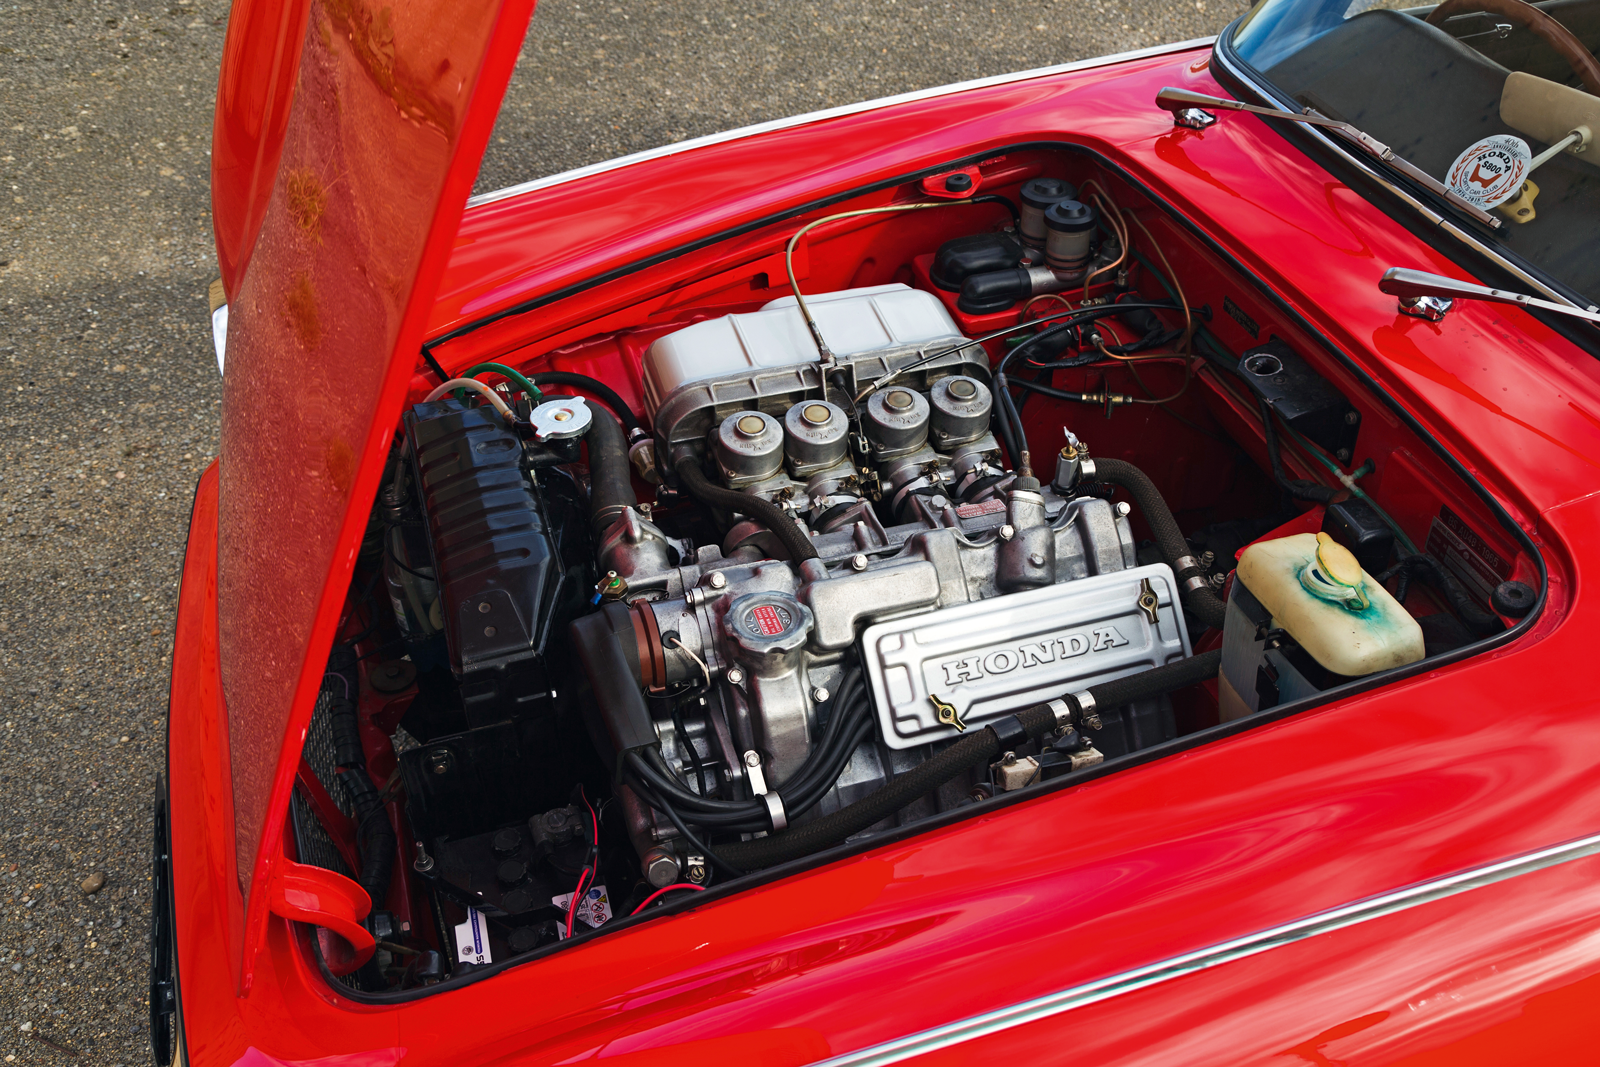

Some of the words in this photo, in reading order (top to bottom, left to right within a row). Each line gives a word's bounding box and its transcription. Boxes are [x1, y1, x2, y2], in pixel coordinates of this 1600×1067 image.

[1476, 151, 1512, 174] HONDA
[1481, 160, 1502, 174] S800
[1463, 170, 1471, 191] SPORTS
[1482, 184, 1499, 195] CLUB
[941, 625, 1130, 686] HONDA
